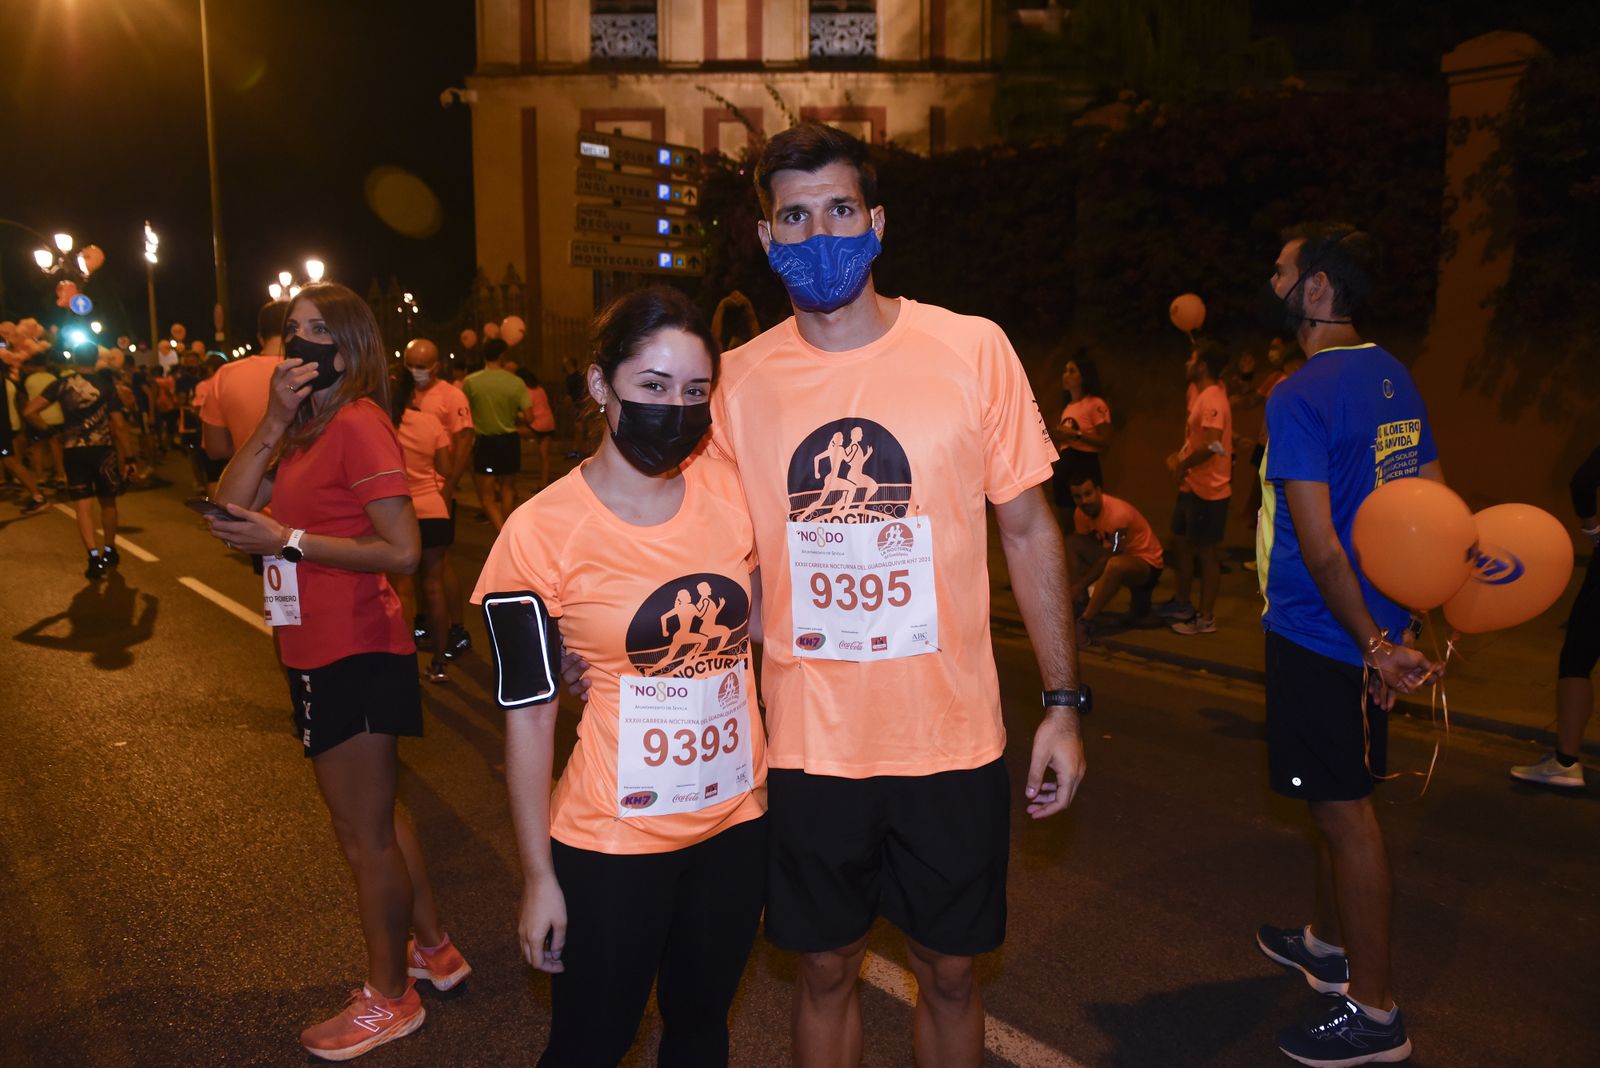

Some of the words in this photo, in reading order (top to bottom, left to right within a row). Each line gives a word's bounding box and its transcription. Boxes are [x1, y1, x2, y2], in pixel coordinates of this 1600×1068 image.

[574, 254, 654, 267] MONTECARLO
[868, 559, 906, 570] GUADALQUIVIR
[810, 569, 912, 612] 9395
[912, 632, 928, 641] ABC
[643, 717, 739, 767] 9393
